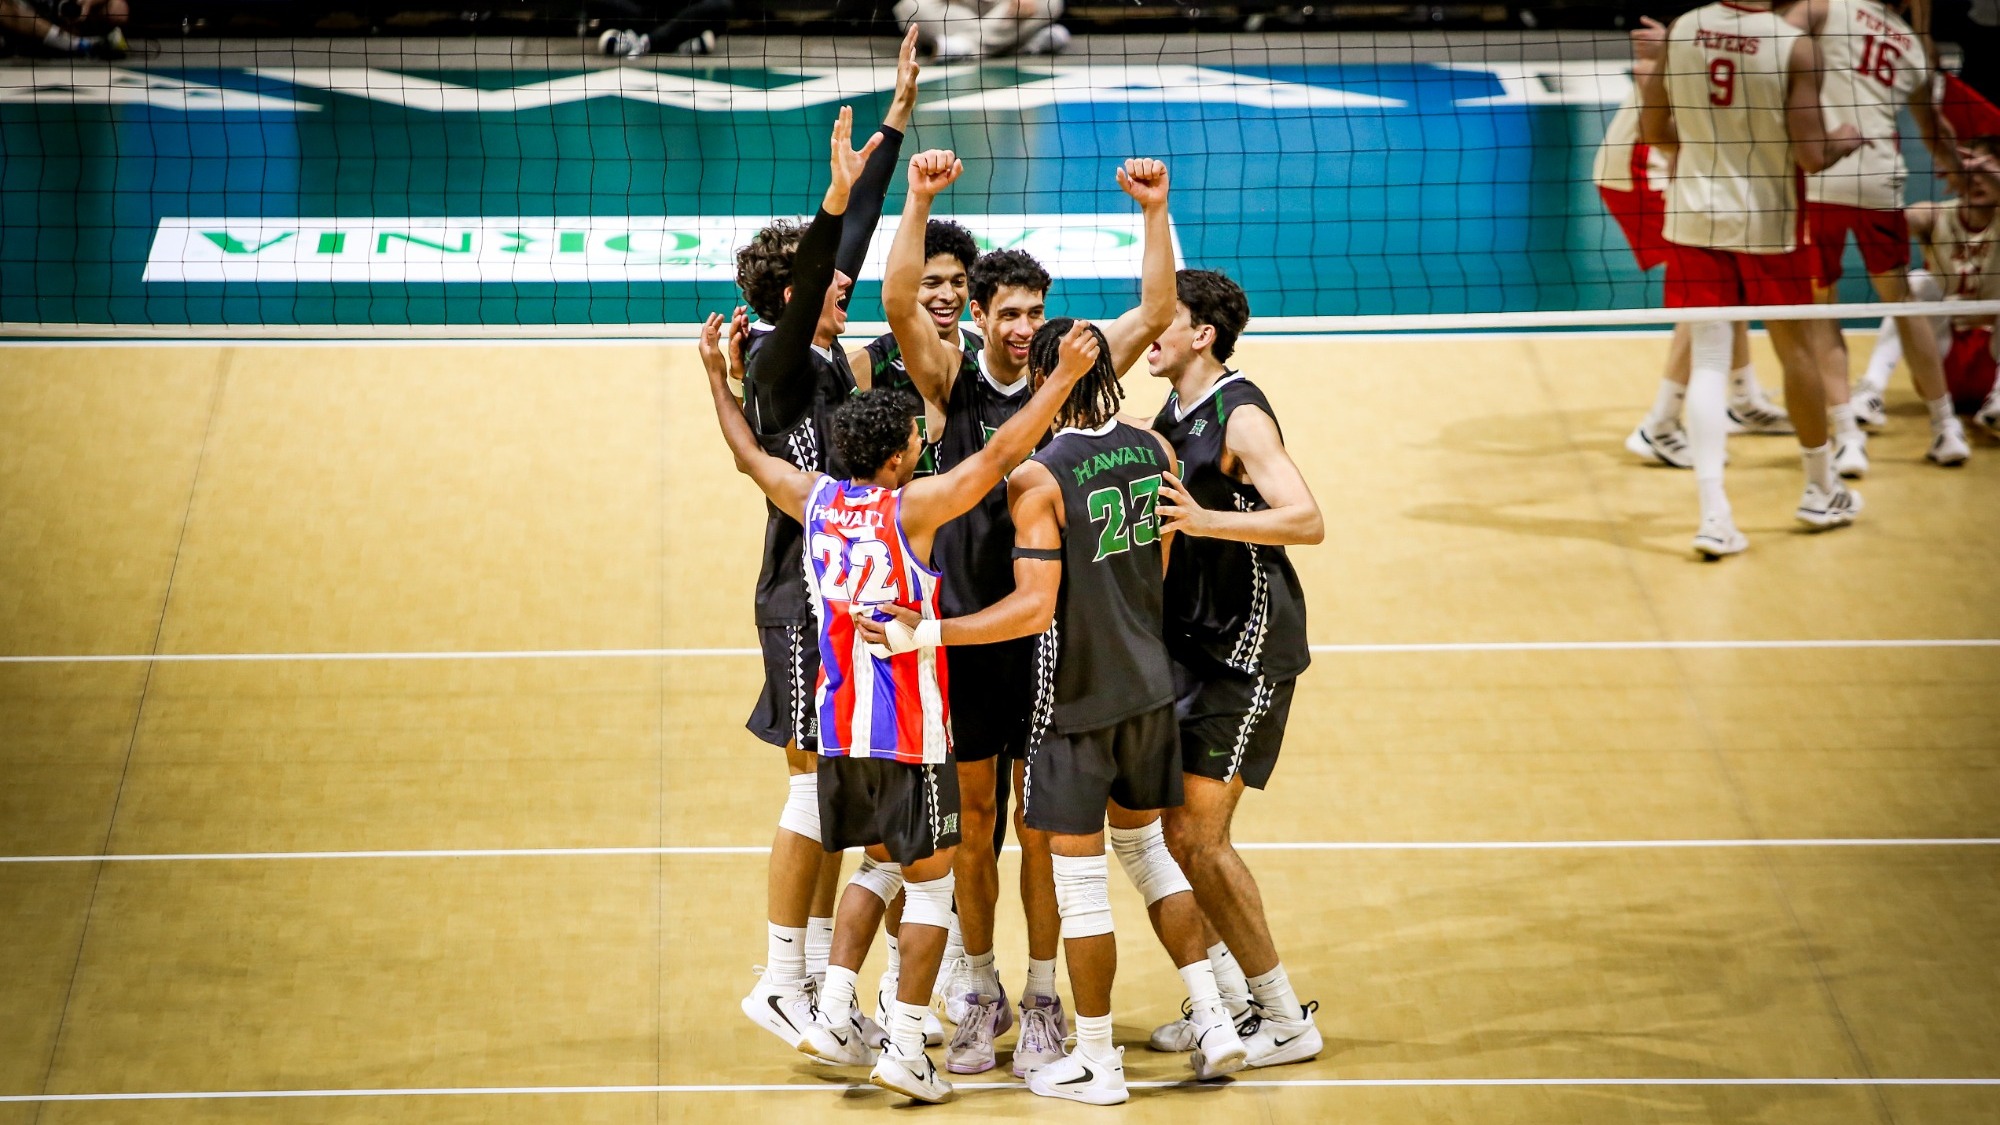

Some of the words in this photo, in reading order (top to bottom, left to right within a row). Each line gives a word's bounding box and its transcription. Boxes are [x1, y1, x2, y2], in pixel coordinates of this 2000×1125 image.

[1708, 57, 1736, 106] 9
[1857, 34, 1902, 88] 16
[201, 224, 1138, 254] CAORNIA
[1087, 474, 1162, 562] 23
[811, 531, 900, 602] 22
